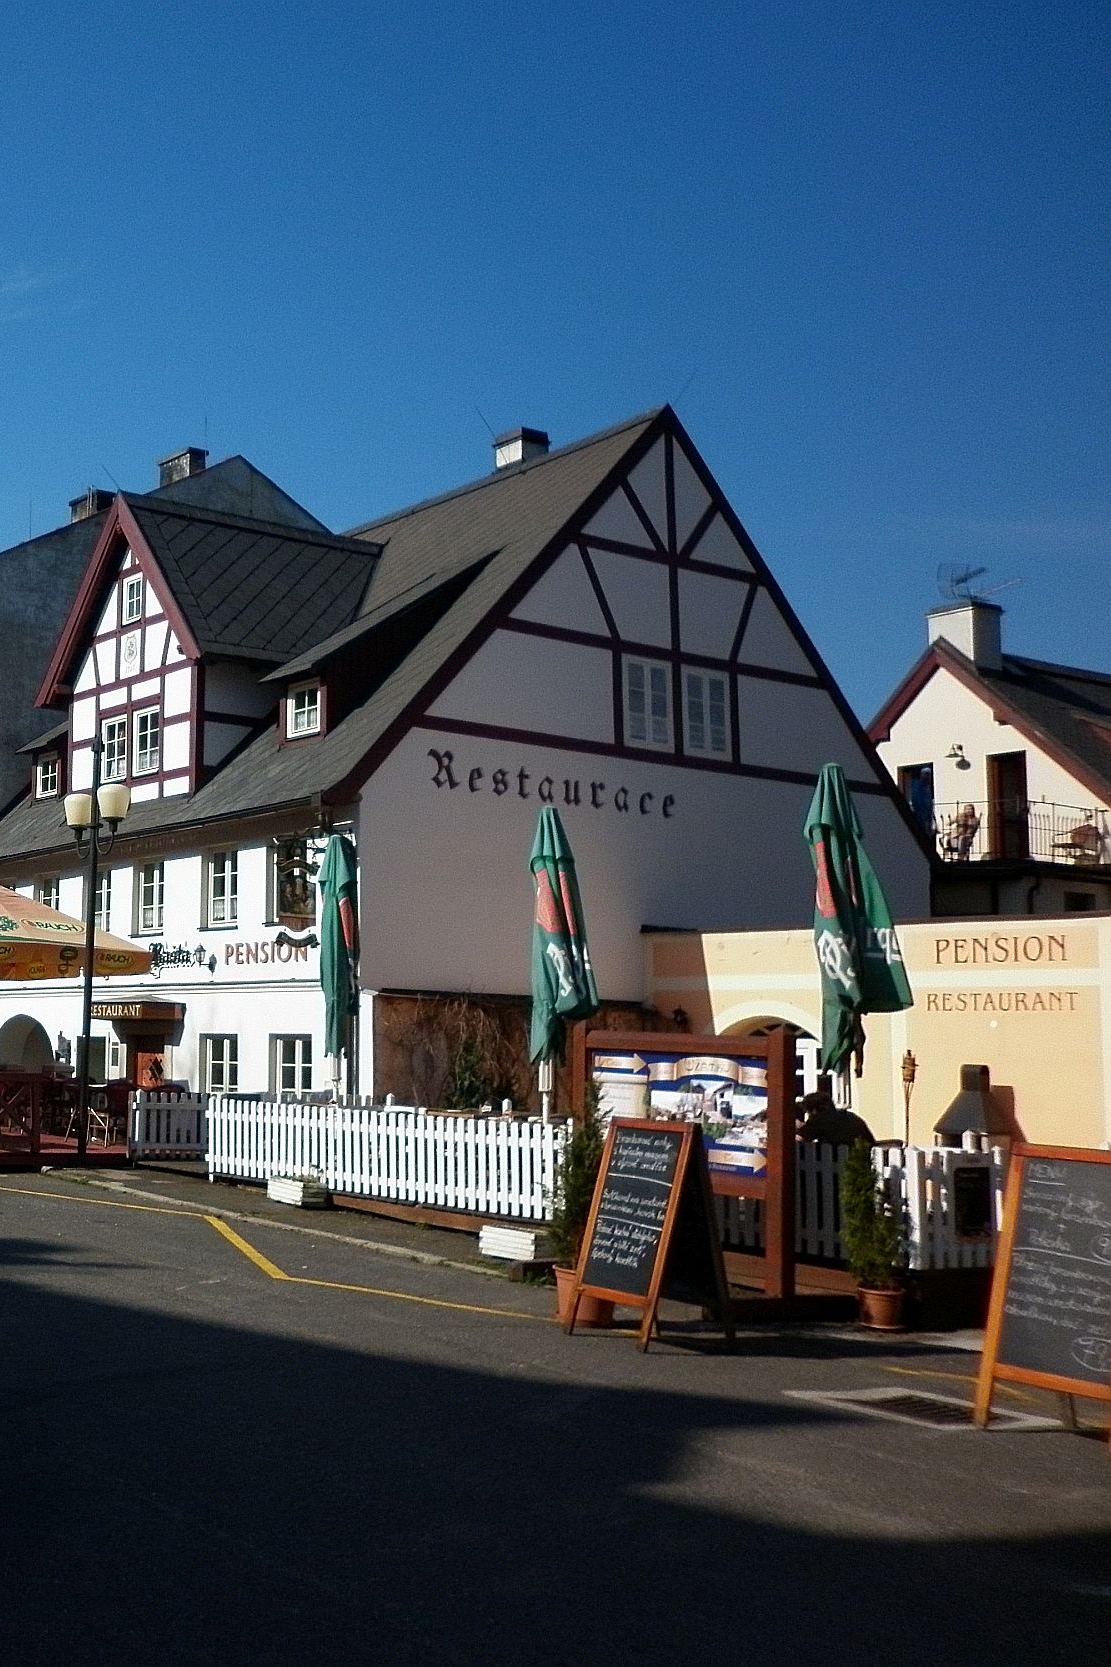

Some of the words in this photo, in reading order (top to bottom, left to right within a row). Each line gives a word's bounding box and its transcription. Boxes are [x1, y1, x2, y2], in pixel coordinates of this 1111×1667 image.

[427, 748, 678, 819] Restaurace
[37, 919, 78, 933] RAUCH
[104, 953, 130, 964] RAUCH
[224, 941, 309, 966] PENSION
[935, 934, 1069, 965] PENSION
[927, 991, 1079, 1011] RESTAURANT
